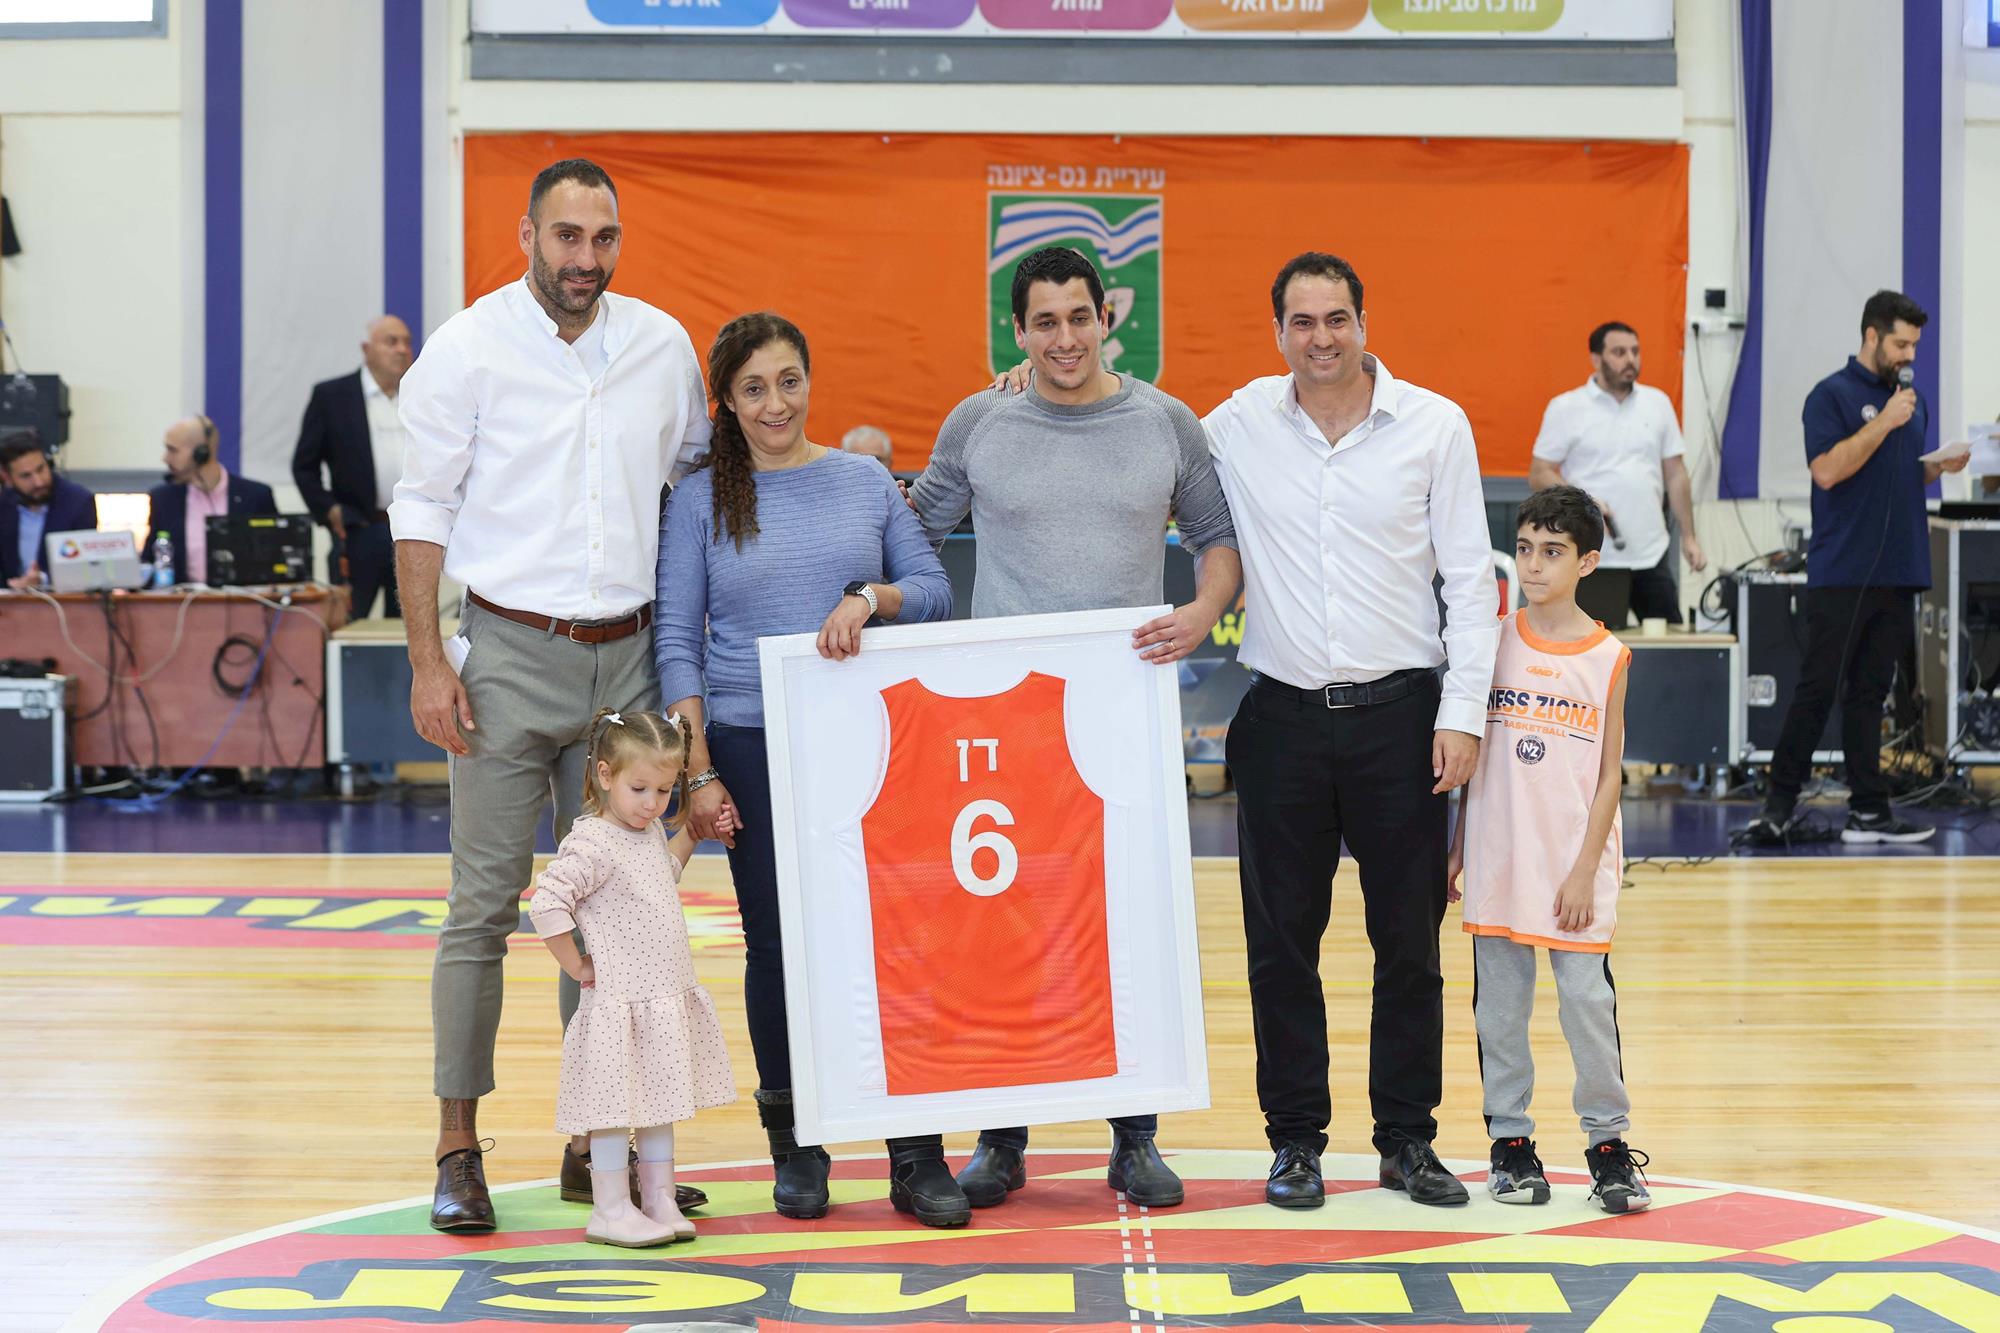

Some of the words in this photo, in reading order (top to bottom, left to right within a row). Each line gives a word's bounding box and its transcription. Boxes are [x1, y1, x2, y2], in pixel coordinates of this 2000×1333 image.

[987, 164, 1087, 188] נס-ציונה
[1094, 166, 1166, 189] עיריית
[1487, 689, 1530, 715] NESS
[1532, 695, 1598, 733] ZIONA
[1504, 720, 1568, 737] BASKETBALL
[956, 738, 999, 782] דן
[951, 799, 1019, 897] 6
